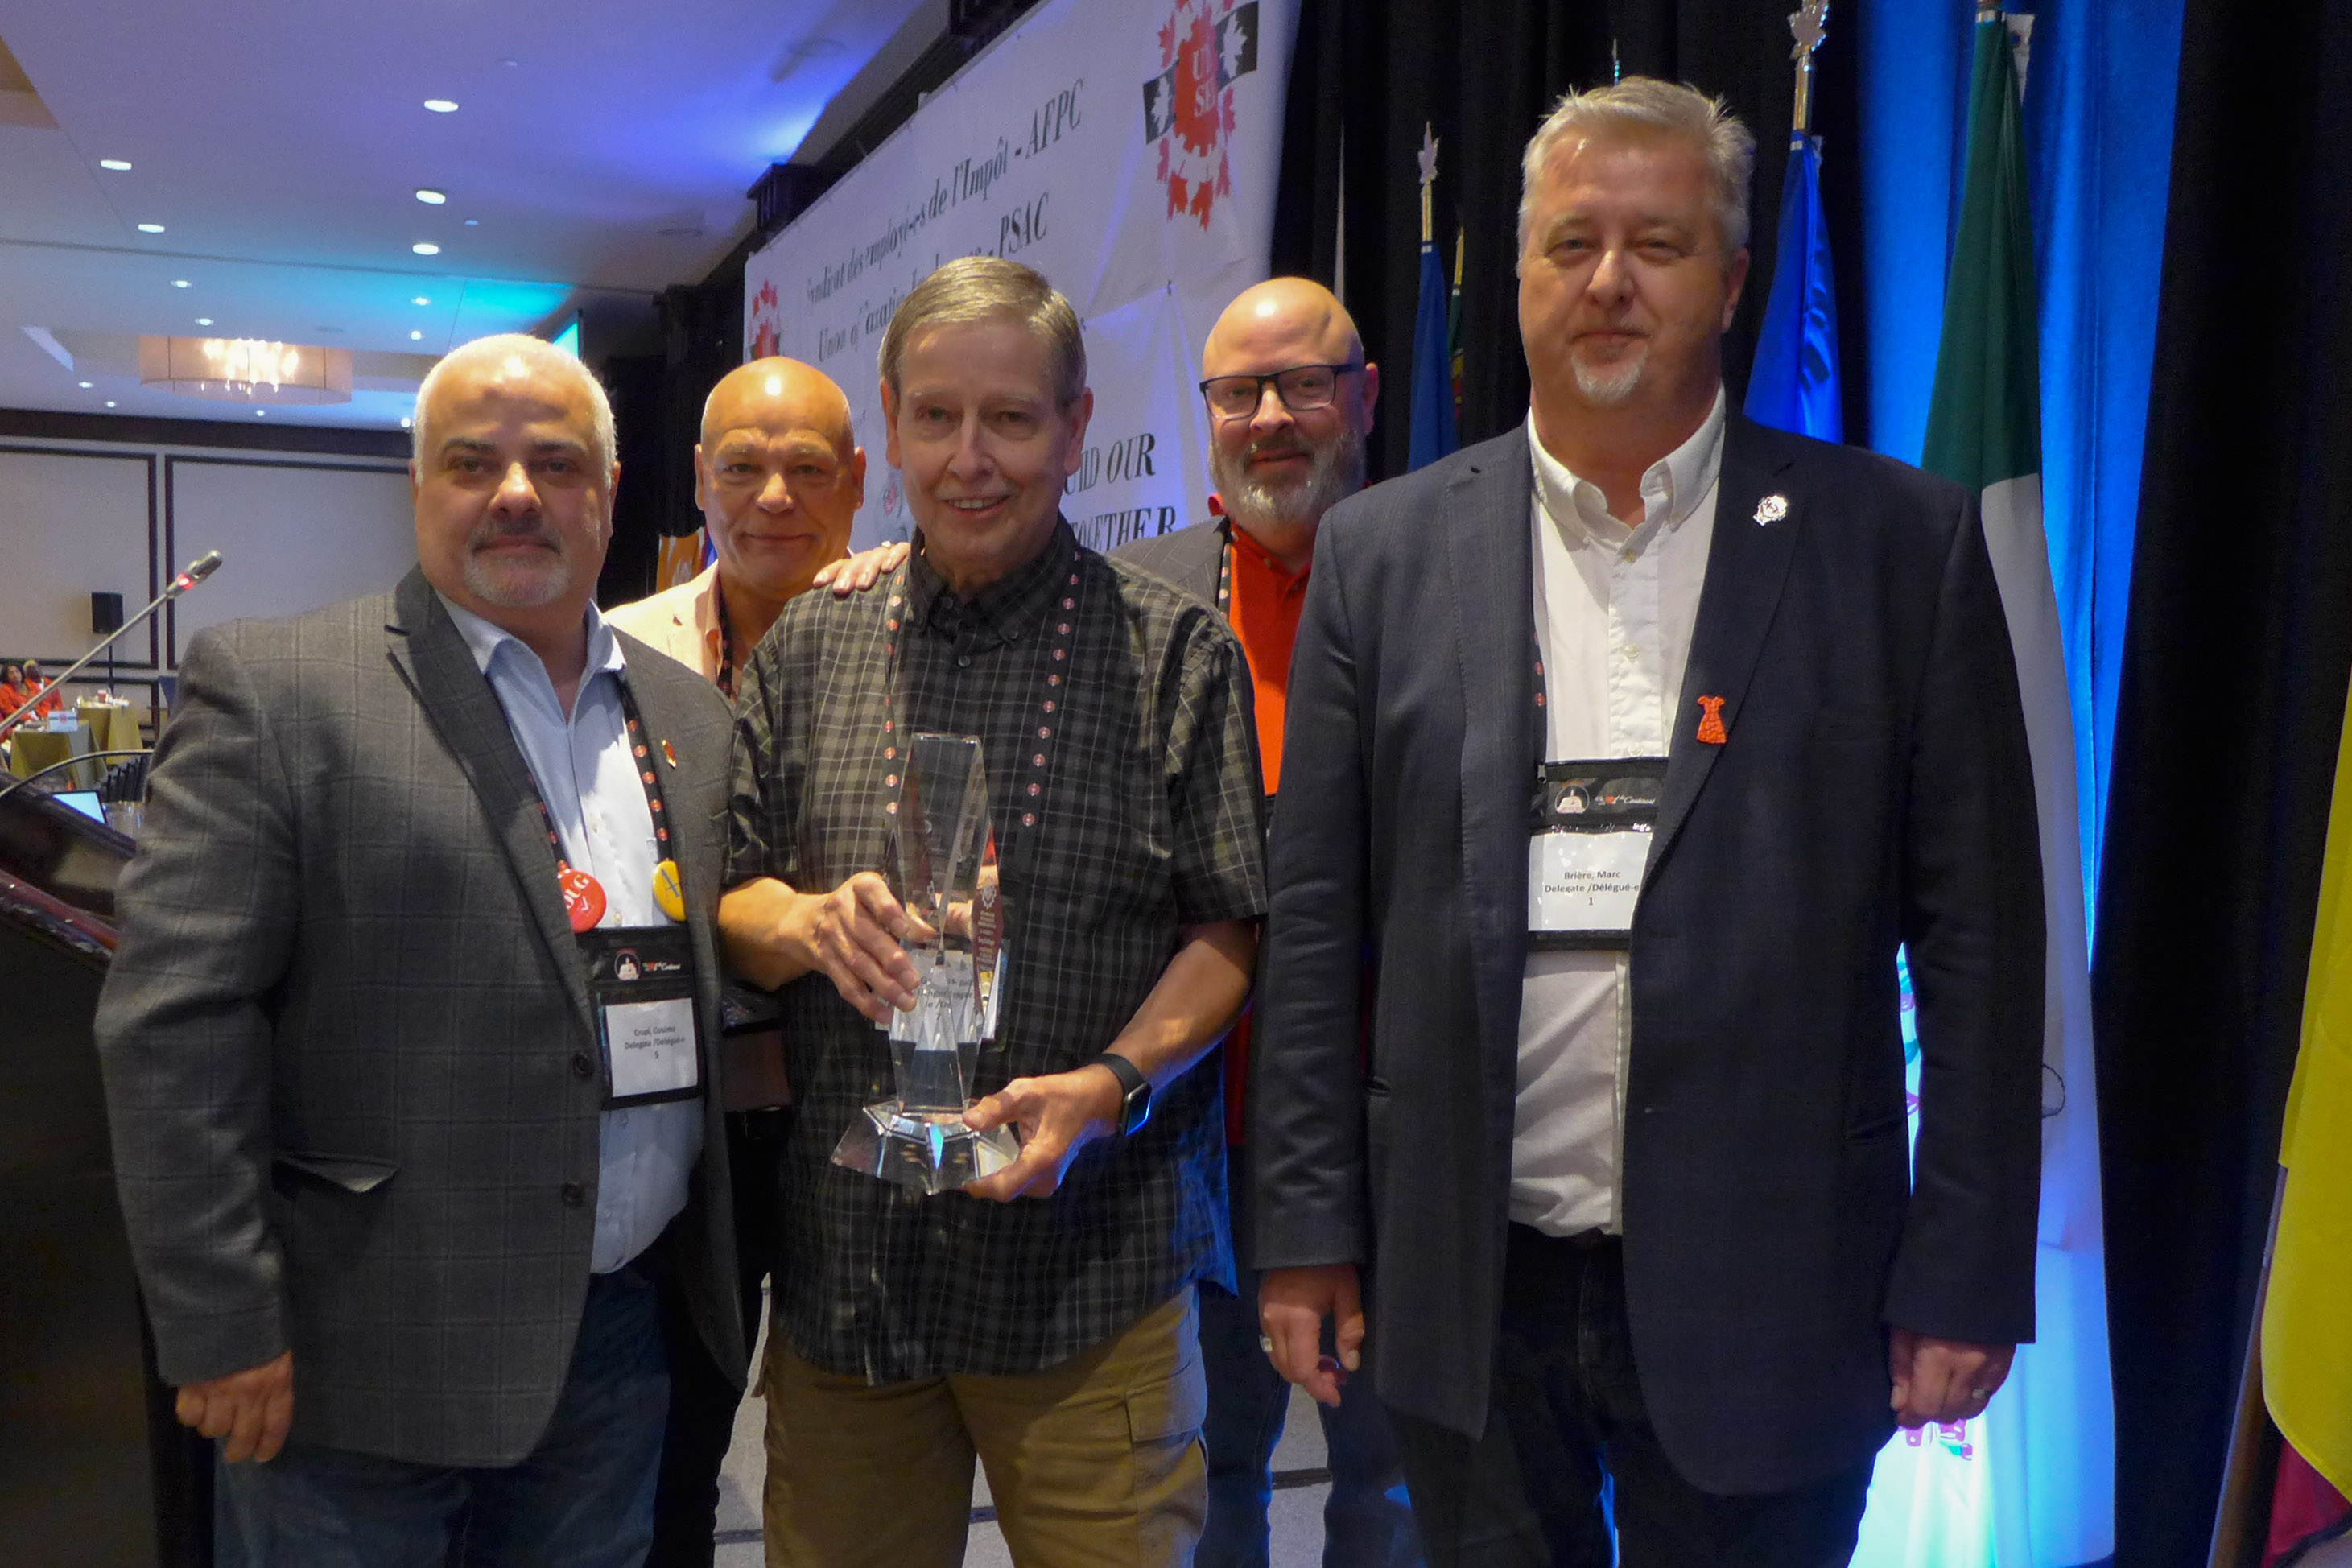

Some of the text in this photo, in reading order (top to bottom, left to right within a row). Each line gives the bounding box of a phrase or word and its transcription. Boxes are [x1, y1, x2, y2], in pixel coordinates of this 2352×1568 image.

[848, 247, 863, 283] des
[928, 177, 947, 221] de
[951, 135, 1009, 208] l'Impôt
[1025, 77, 1085, 159] AFPC
[997, 191, 1050, 258] PSAC
[1106, 432, 1156, 484] OUR
[1545, 884, 1586, 893] Delegate
[1564, 870, 1621, 881] Brière, Marc
[1589, 897, 1594, 906] 1
